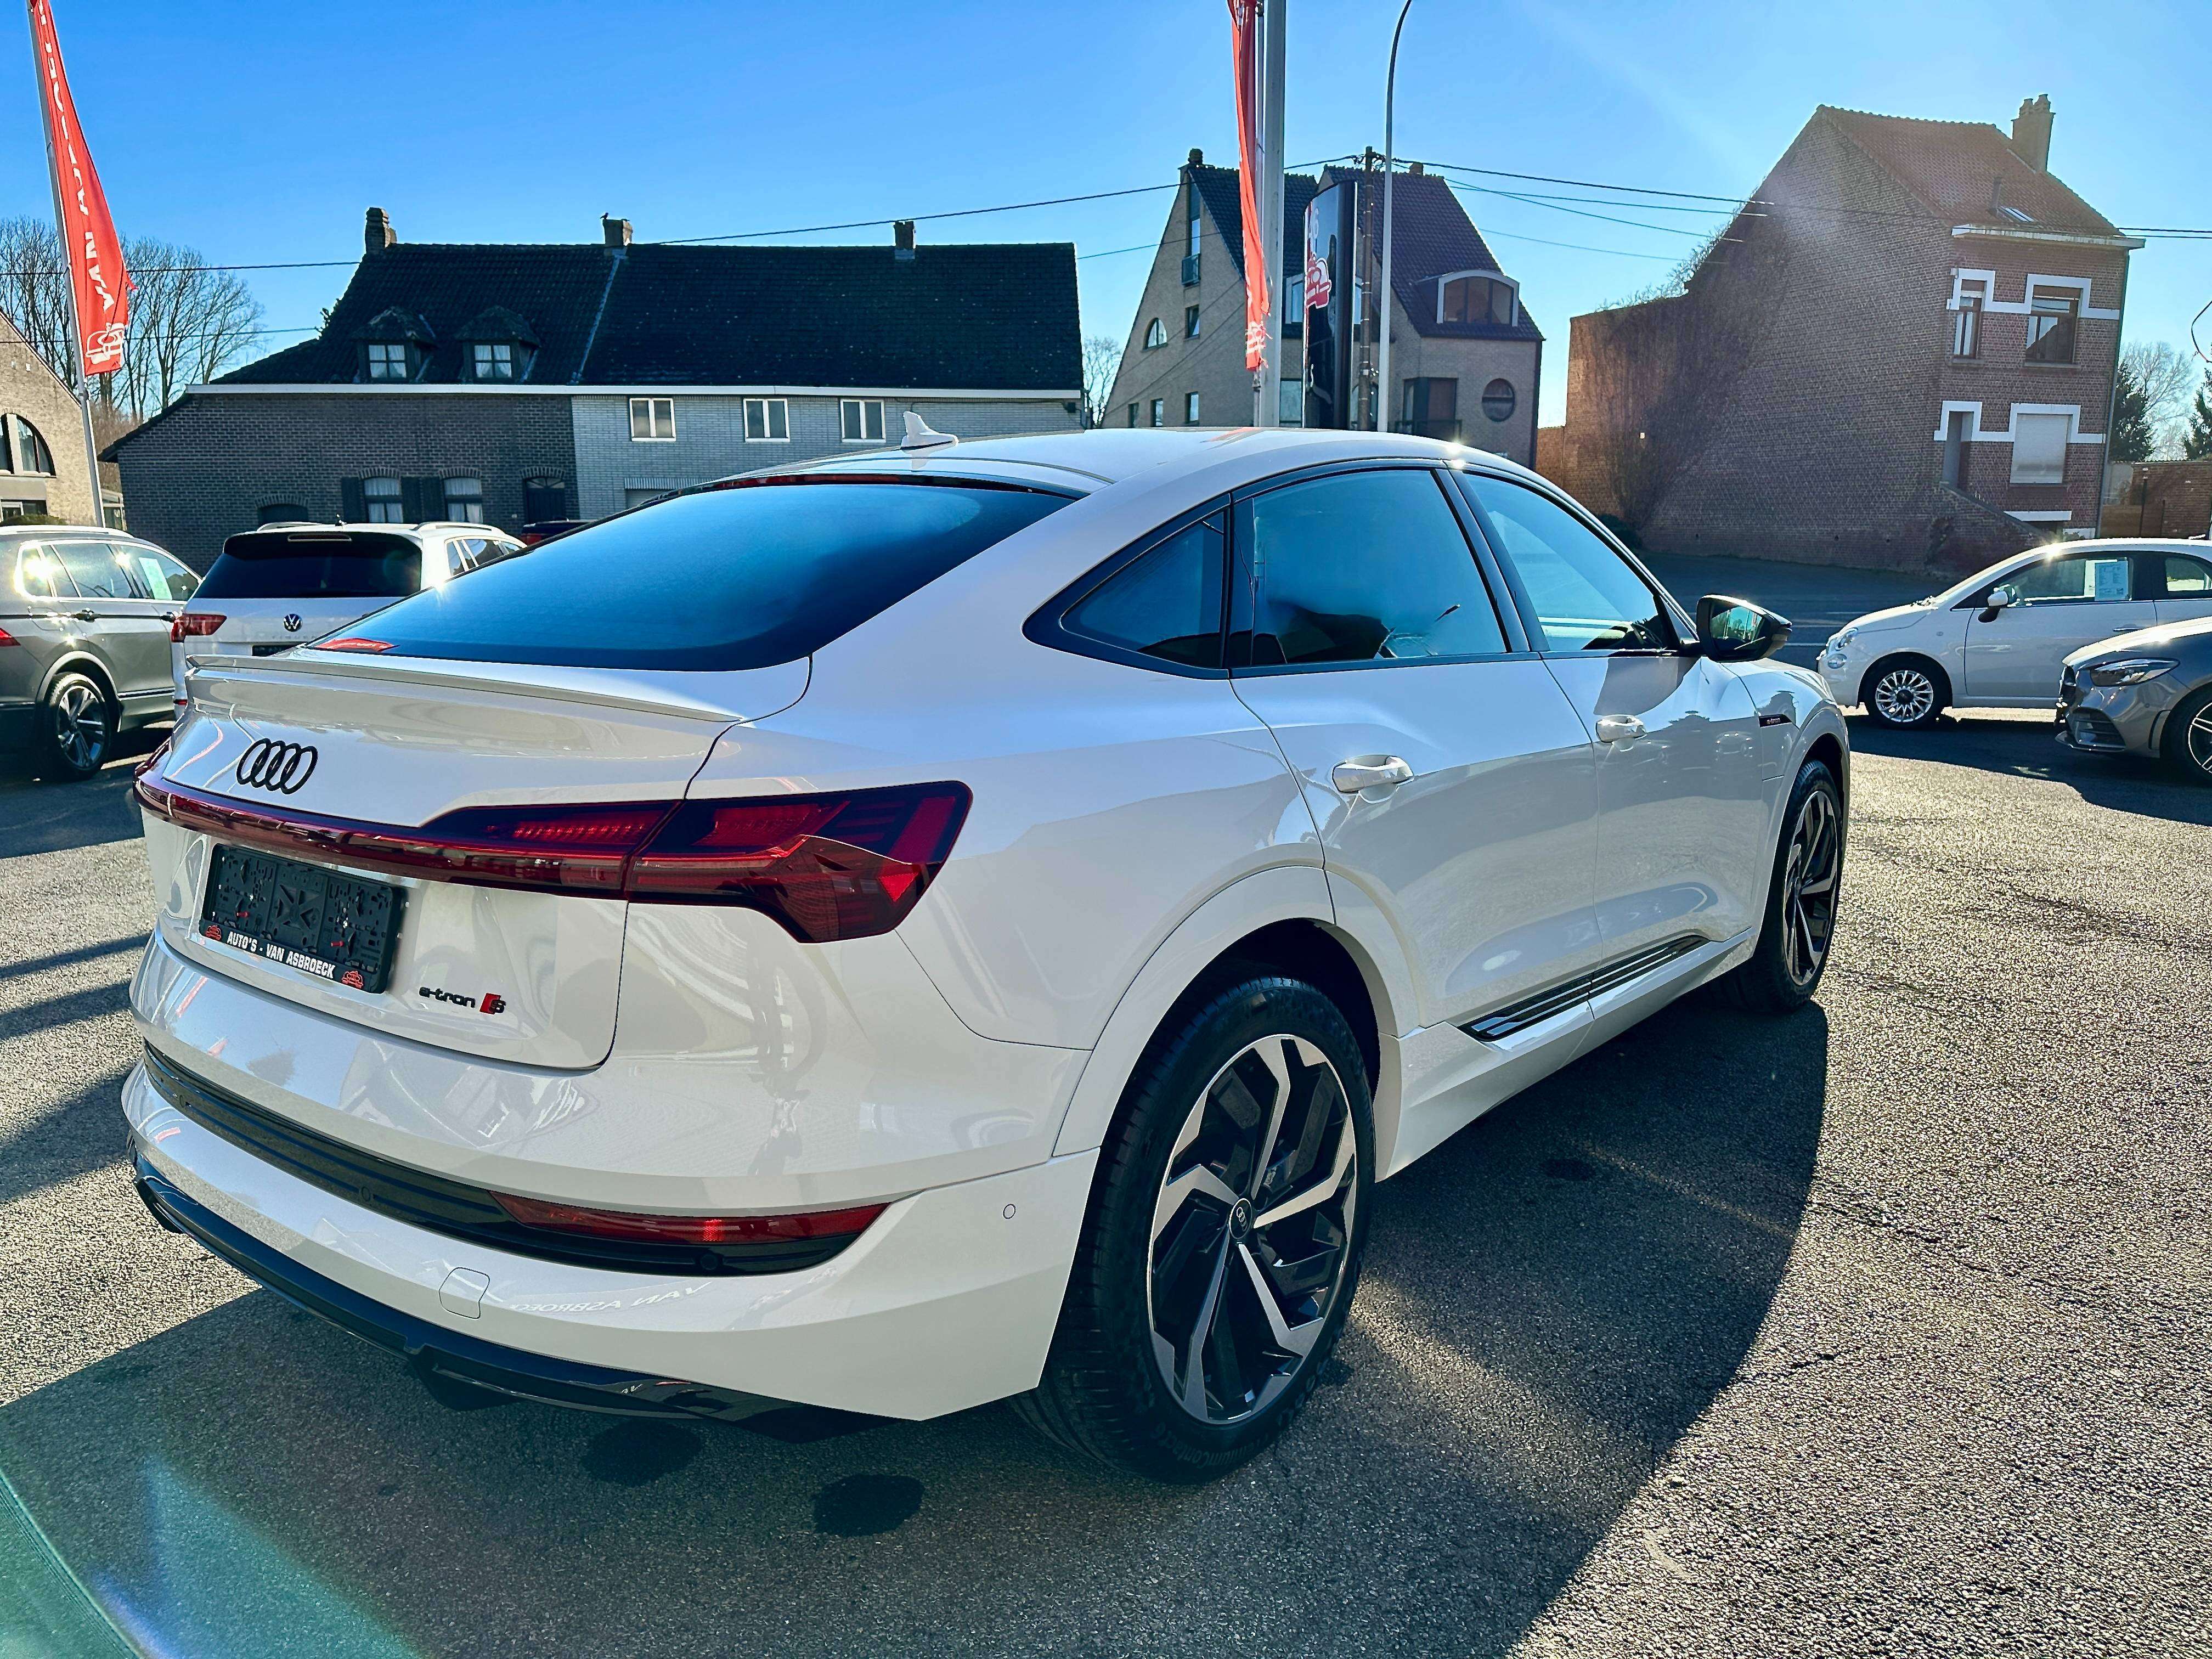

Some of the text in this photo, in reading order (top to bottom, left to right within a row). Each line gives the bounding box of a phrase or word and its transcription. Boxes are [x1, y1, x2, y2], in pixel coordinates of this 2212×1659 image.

[85, 232, 114, 312] VAN
[227, 931, 258, 952] AUTO'S
[266, 943, 285, 962] VAN
[286, 951, 336, 979] ASBROECK
[419, 986, 476, 1008] e-tron
